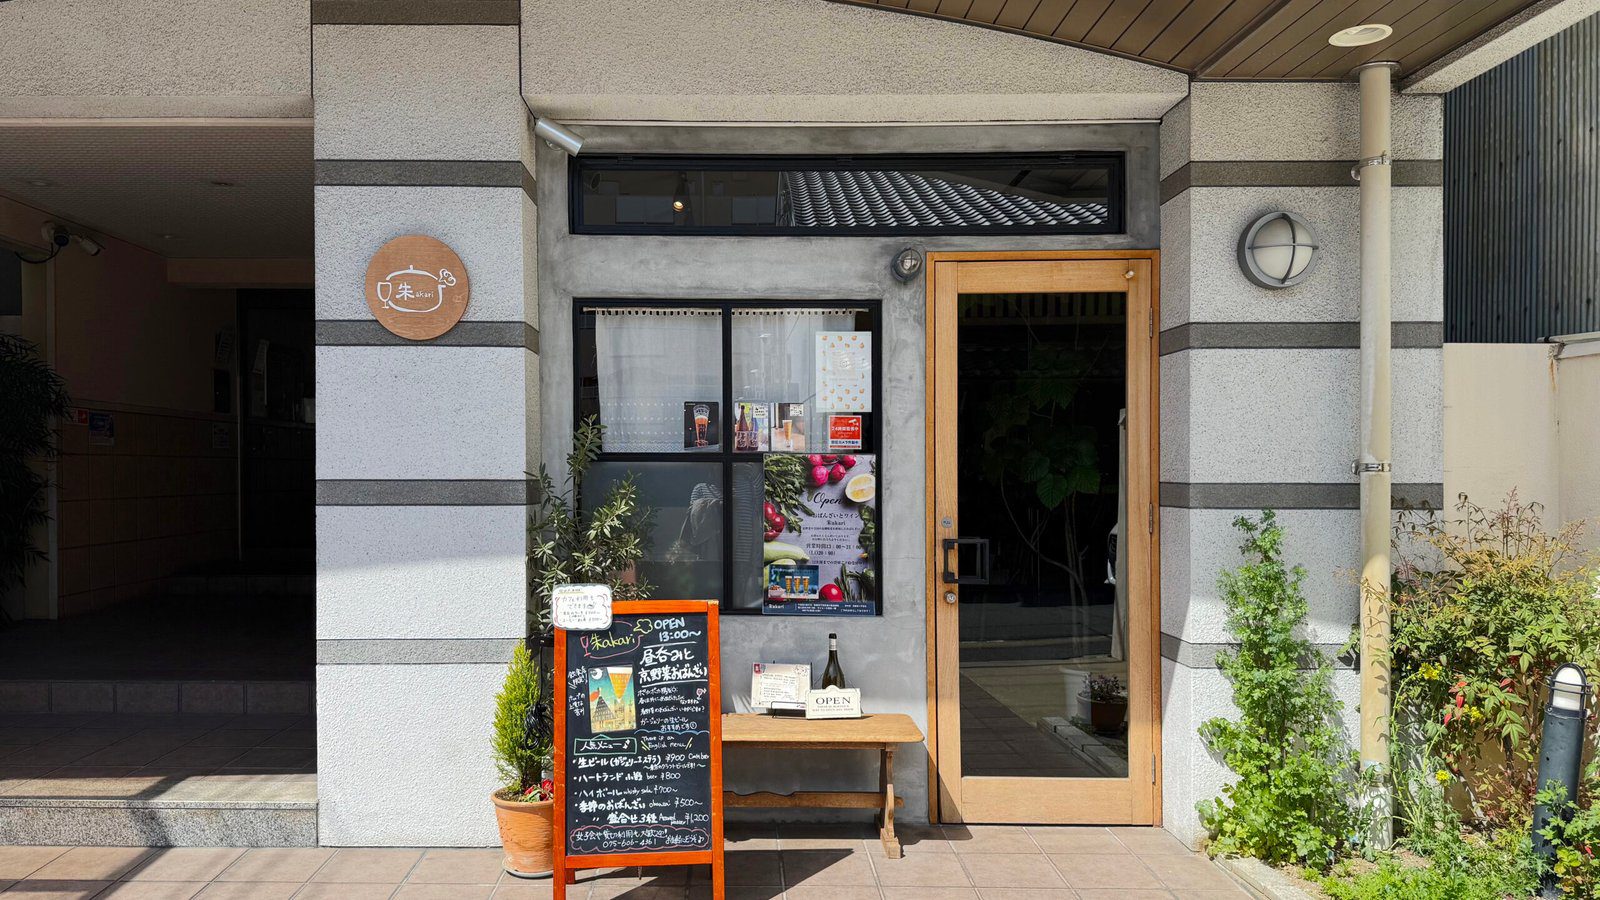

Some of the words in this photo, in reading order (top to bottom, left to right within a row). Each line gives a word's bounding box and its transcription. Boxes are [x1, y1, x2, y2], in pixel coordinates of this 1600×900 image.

[813, 492, 842, 509] Open
[654, 617, 686, 631] OPEN
[639, 646, 695, 667] 昼呑みと
[638, 663, 708, 684] 京野菜おばんざい
[815, 697, 851, 705] OPEN
[580, 740, 623, 752] 人気メニュー
[648, 741, 667, 751] English
[578, 797, 646, 813] 季節のおばんざい
